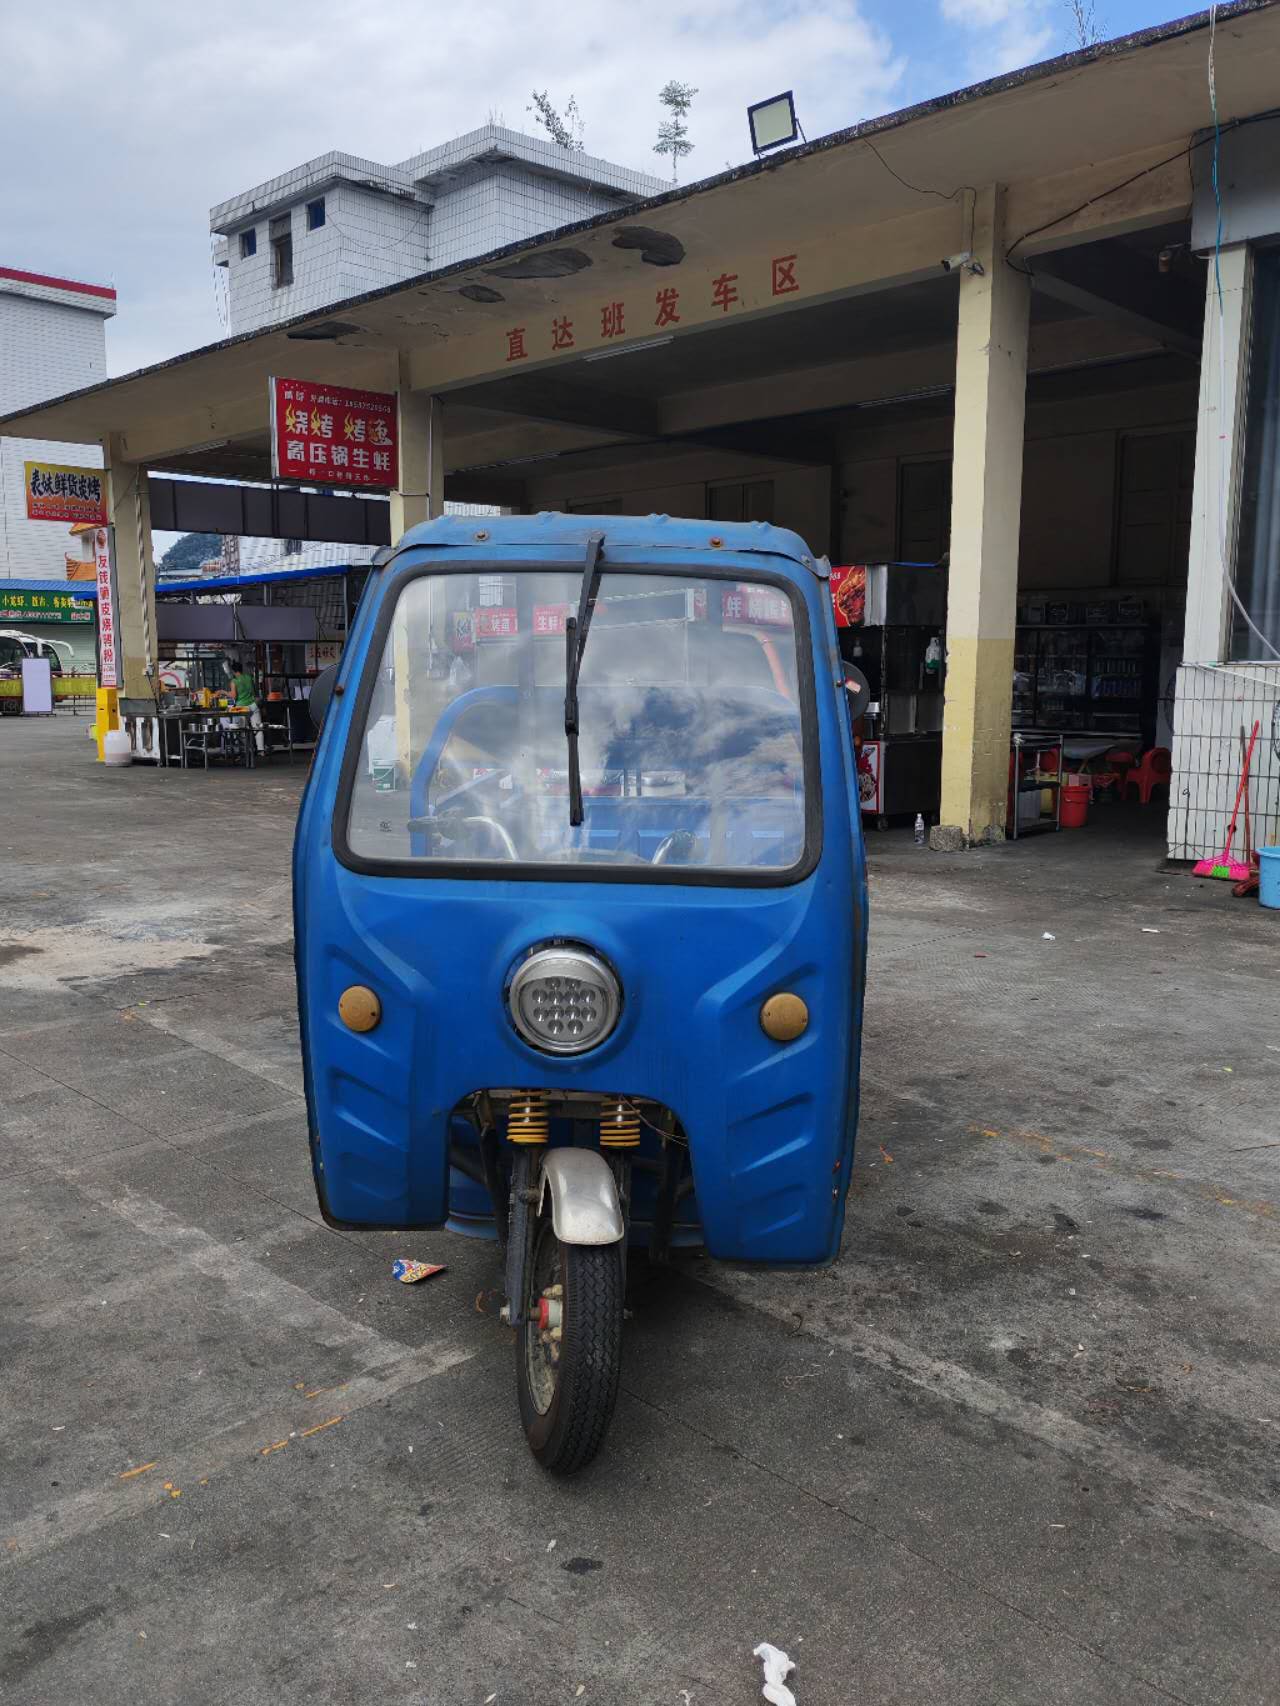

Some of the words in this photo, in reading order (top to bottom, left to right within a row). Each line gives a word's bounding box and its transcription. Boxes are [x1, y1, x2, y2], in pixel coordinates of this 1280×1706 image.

[505, 254, 800, 363] 直达班发车区
[285, 403, 334, 439] 烧烤
[343, 412, 394, 446] 烤鱼
[286, 439, 391, 472] 高压锅生蚝
